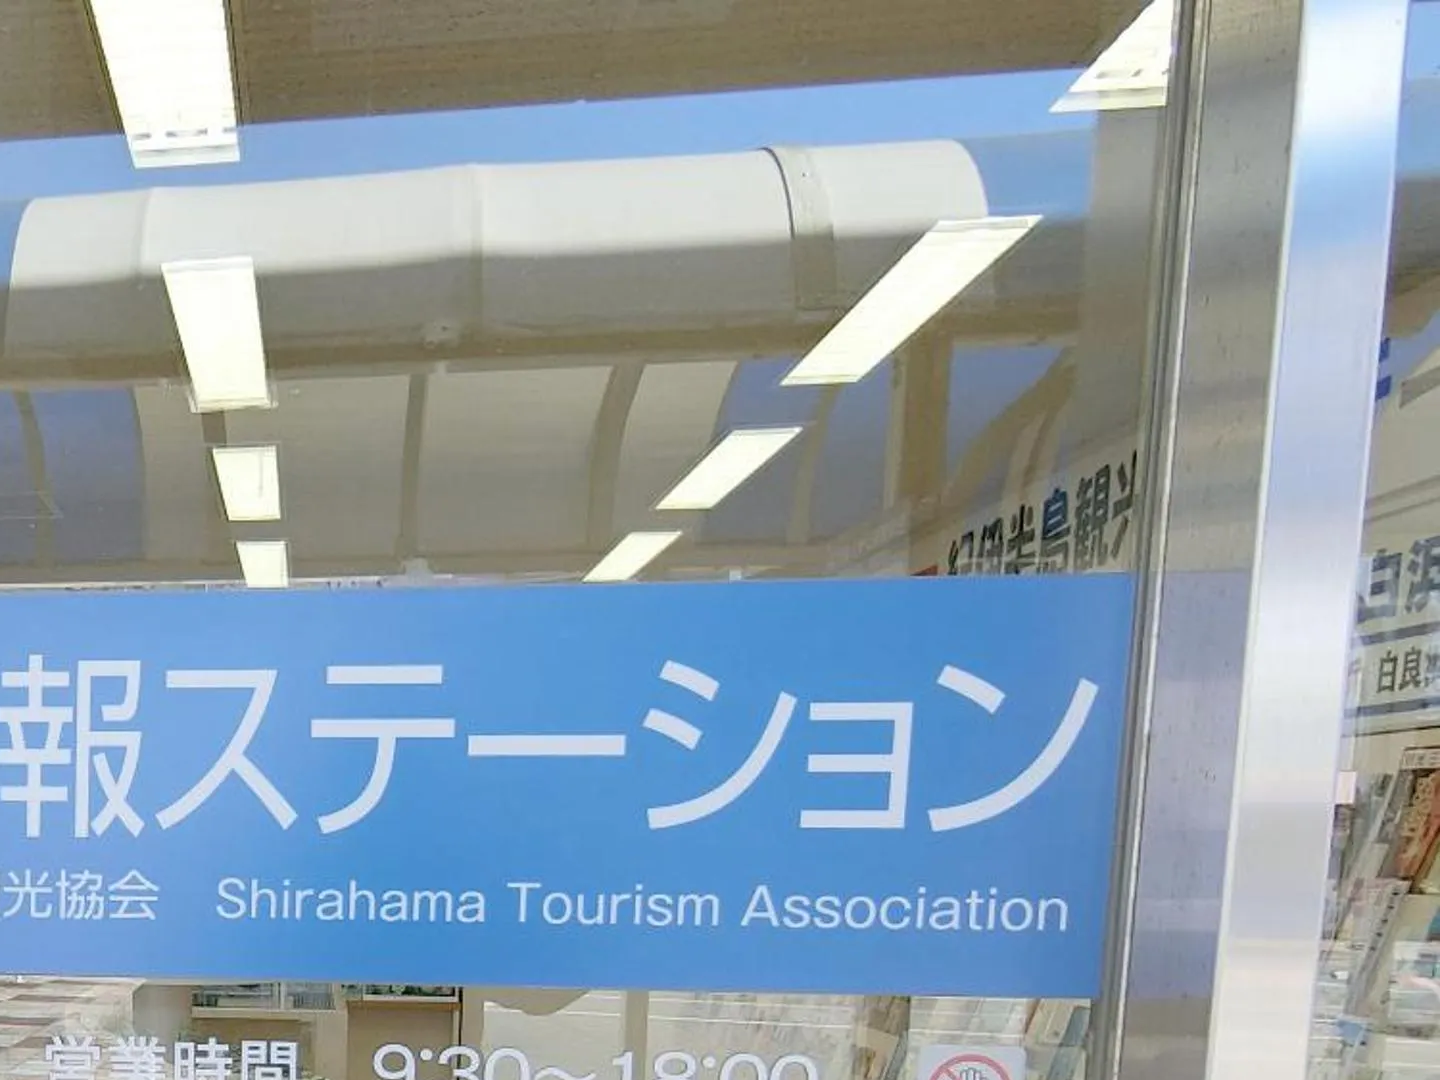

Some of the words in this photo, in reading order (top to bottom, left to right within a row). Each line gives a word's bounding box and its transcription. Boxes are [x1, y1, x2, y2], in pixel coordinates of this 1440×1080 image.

[217, 878, 485, 923] Shirahama
[506, 883, 719, 926] Tourism
[741, 886, 1068, 932] Association
